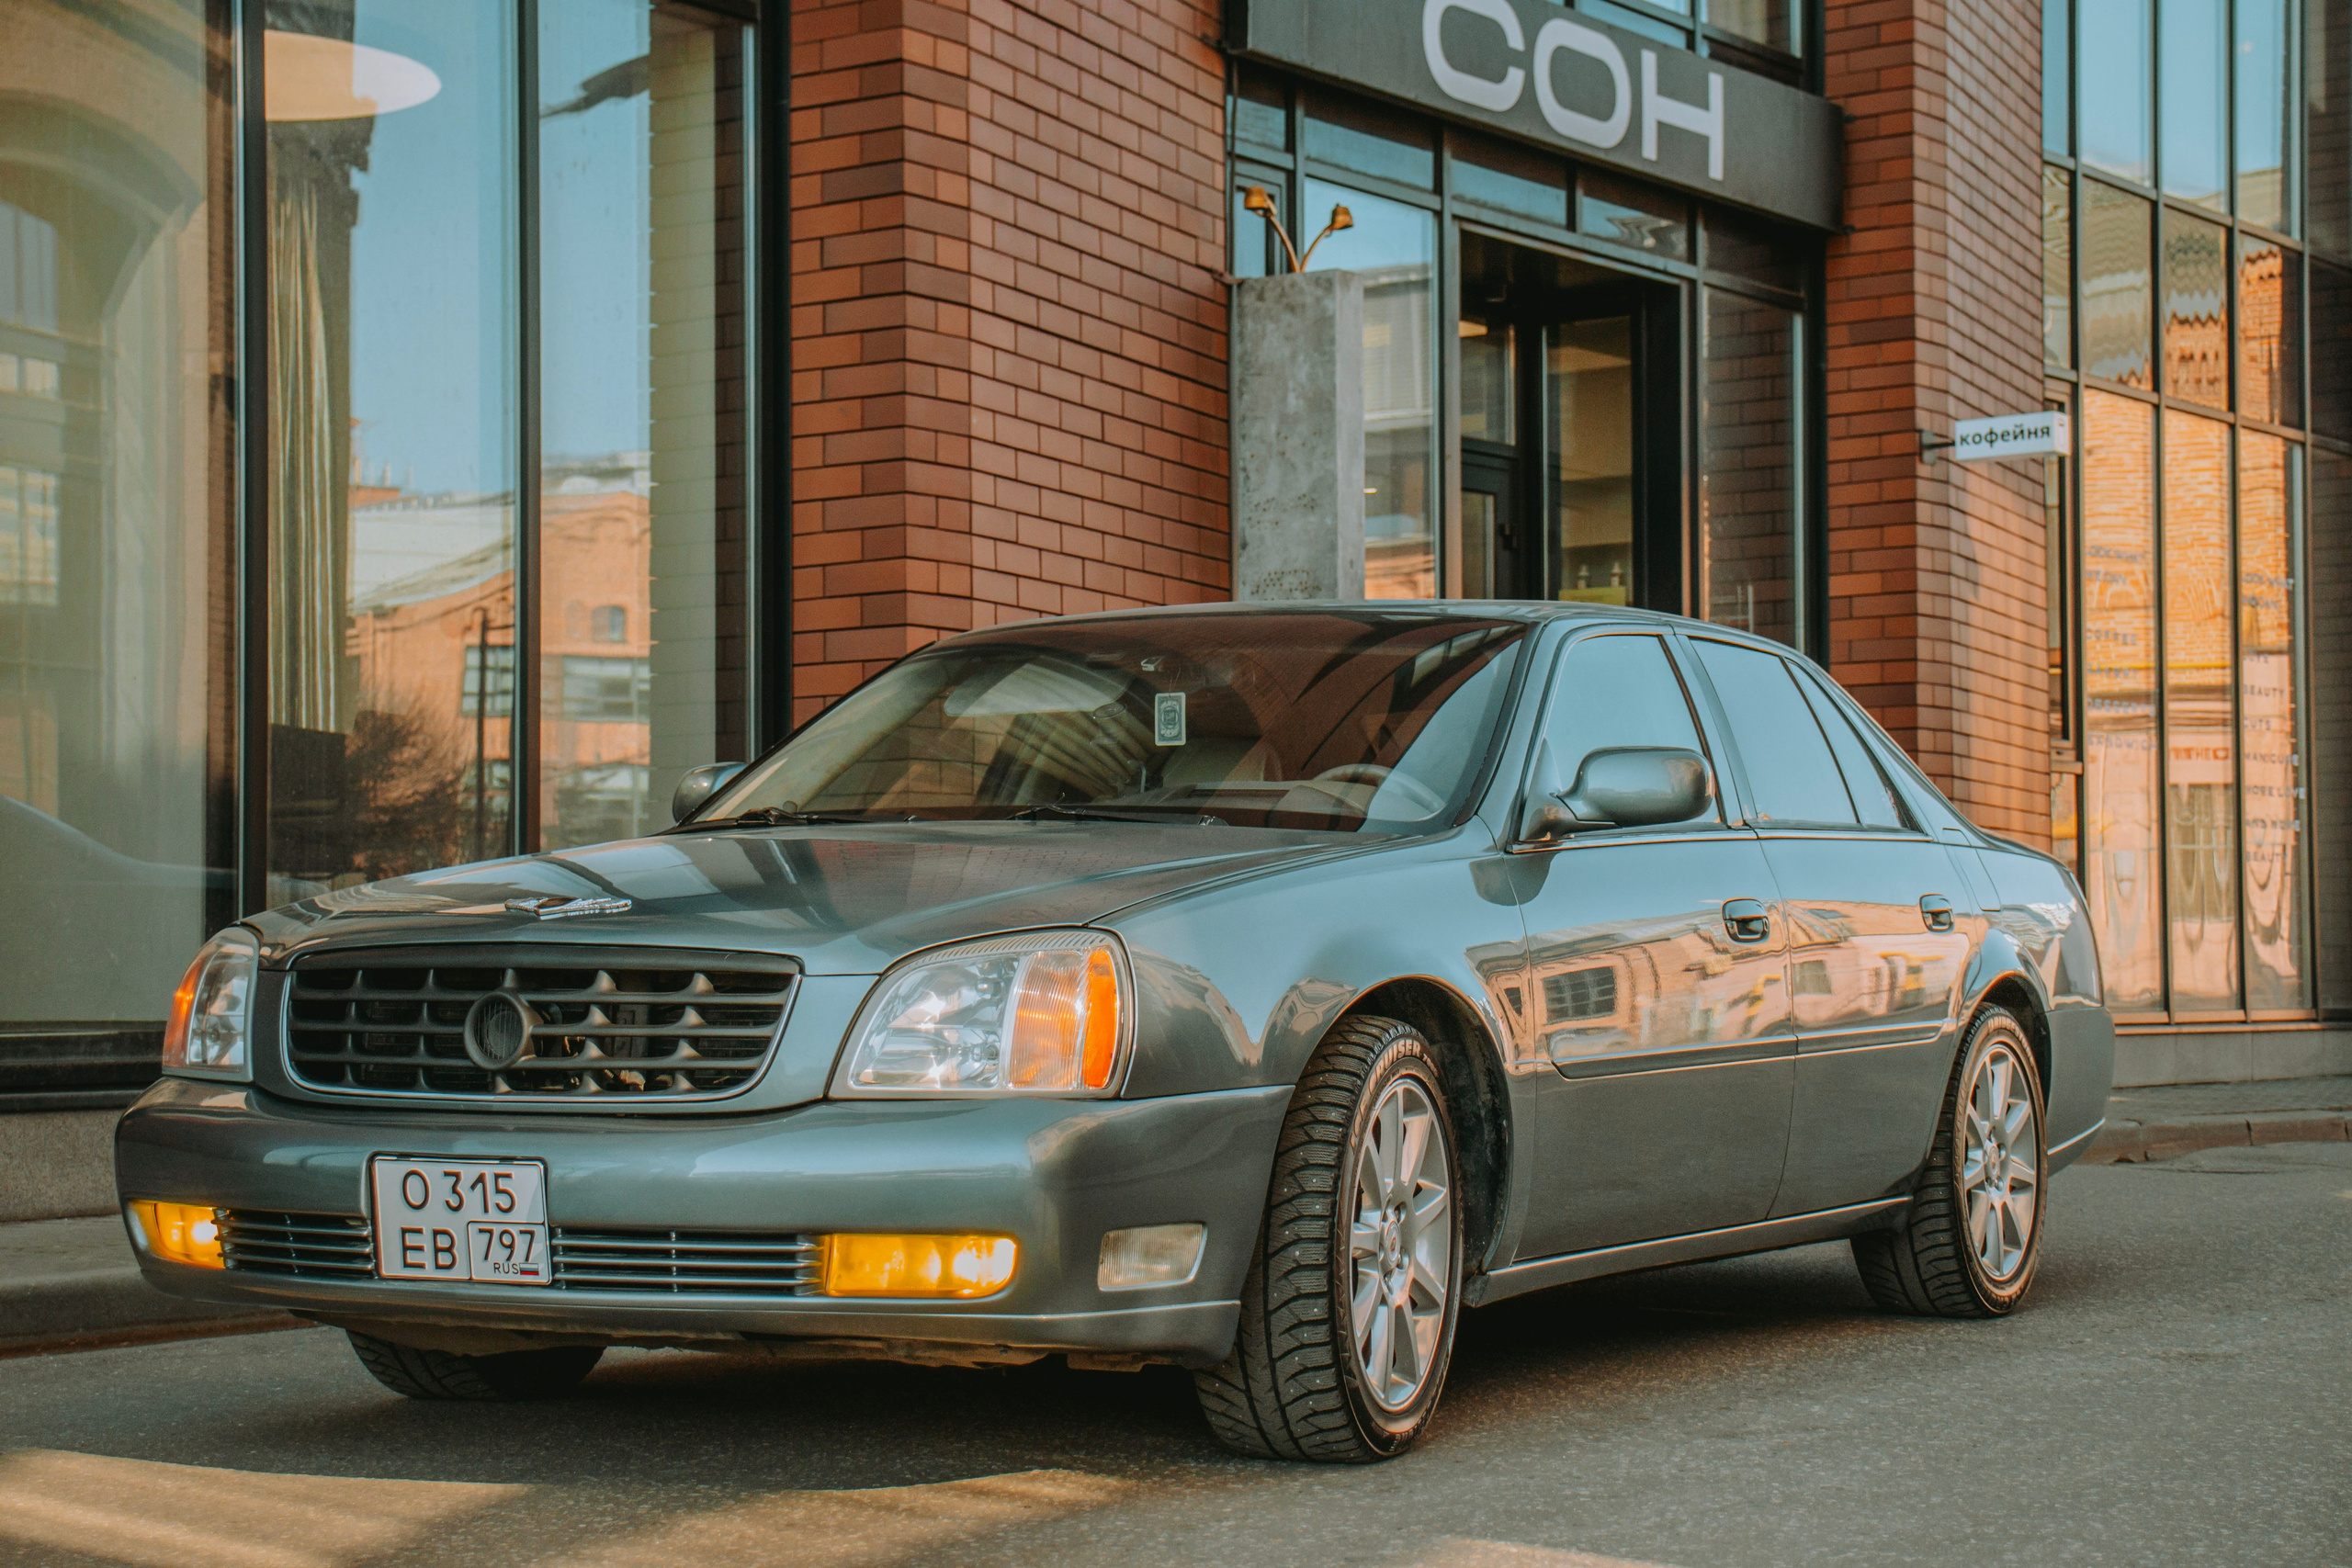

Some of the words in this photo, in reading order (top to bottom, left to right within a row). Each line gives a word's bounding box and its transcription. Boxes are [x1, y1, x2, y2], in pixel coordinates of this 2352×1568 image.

[1959, 423, 2052, 448] кофейня
[2244, 684, 2286, 697] BEAUTY
[443, 1169, 517, 1213] 315
[478, 1227, 537, 1262] 797
[493, 1262, 519, 1275] RUS
